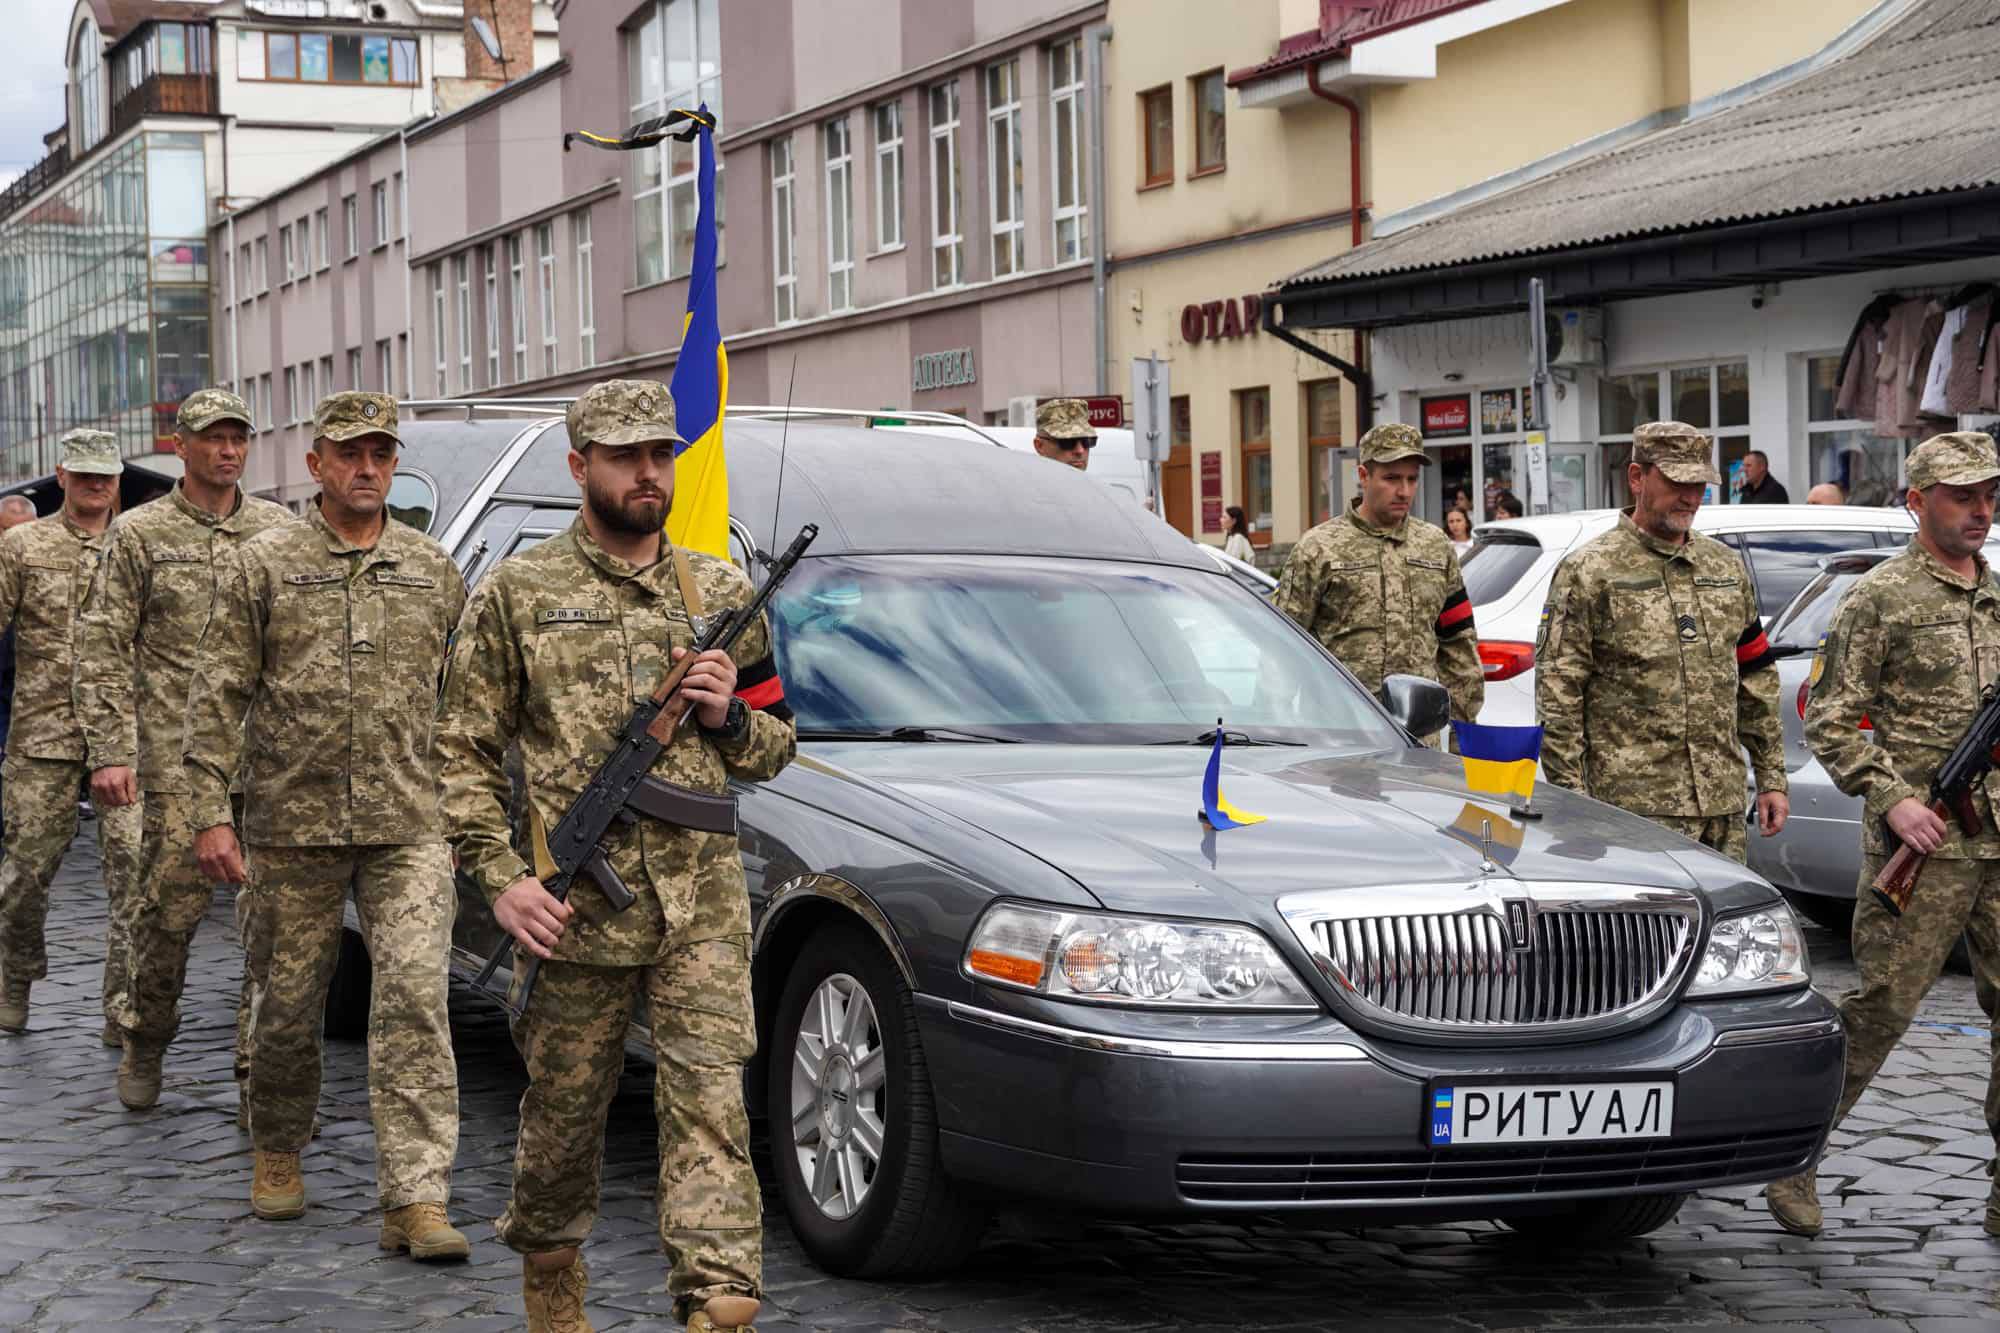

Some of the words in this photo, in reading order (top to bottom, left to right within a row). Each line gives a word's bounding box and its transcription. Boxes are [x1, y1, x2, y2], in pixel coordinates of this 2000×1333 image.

[1181, 291, 1280, 344] ОТАР
[912, 347, 976, 391] АПТЕКА
[1088, 407, 1116, 420] РІУС
[1434, 1124, 1450, 1137] UA
[1463, 1088, 1661, 1137] РИТУАЛ
